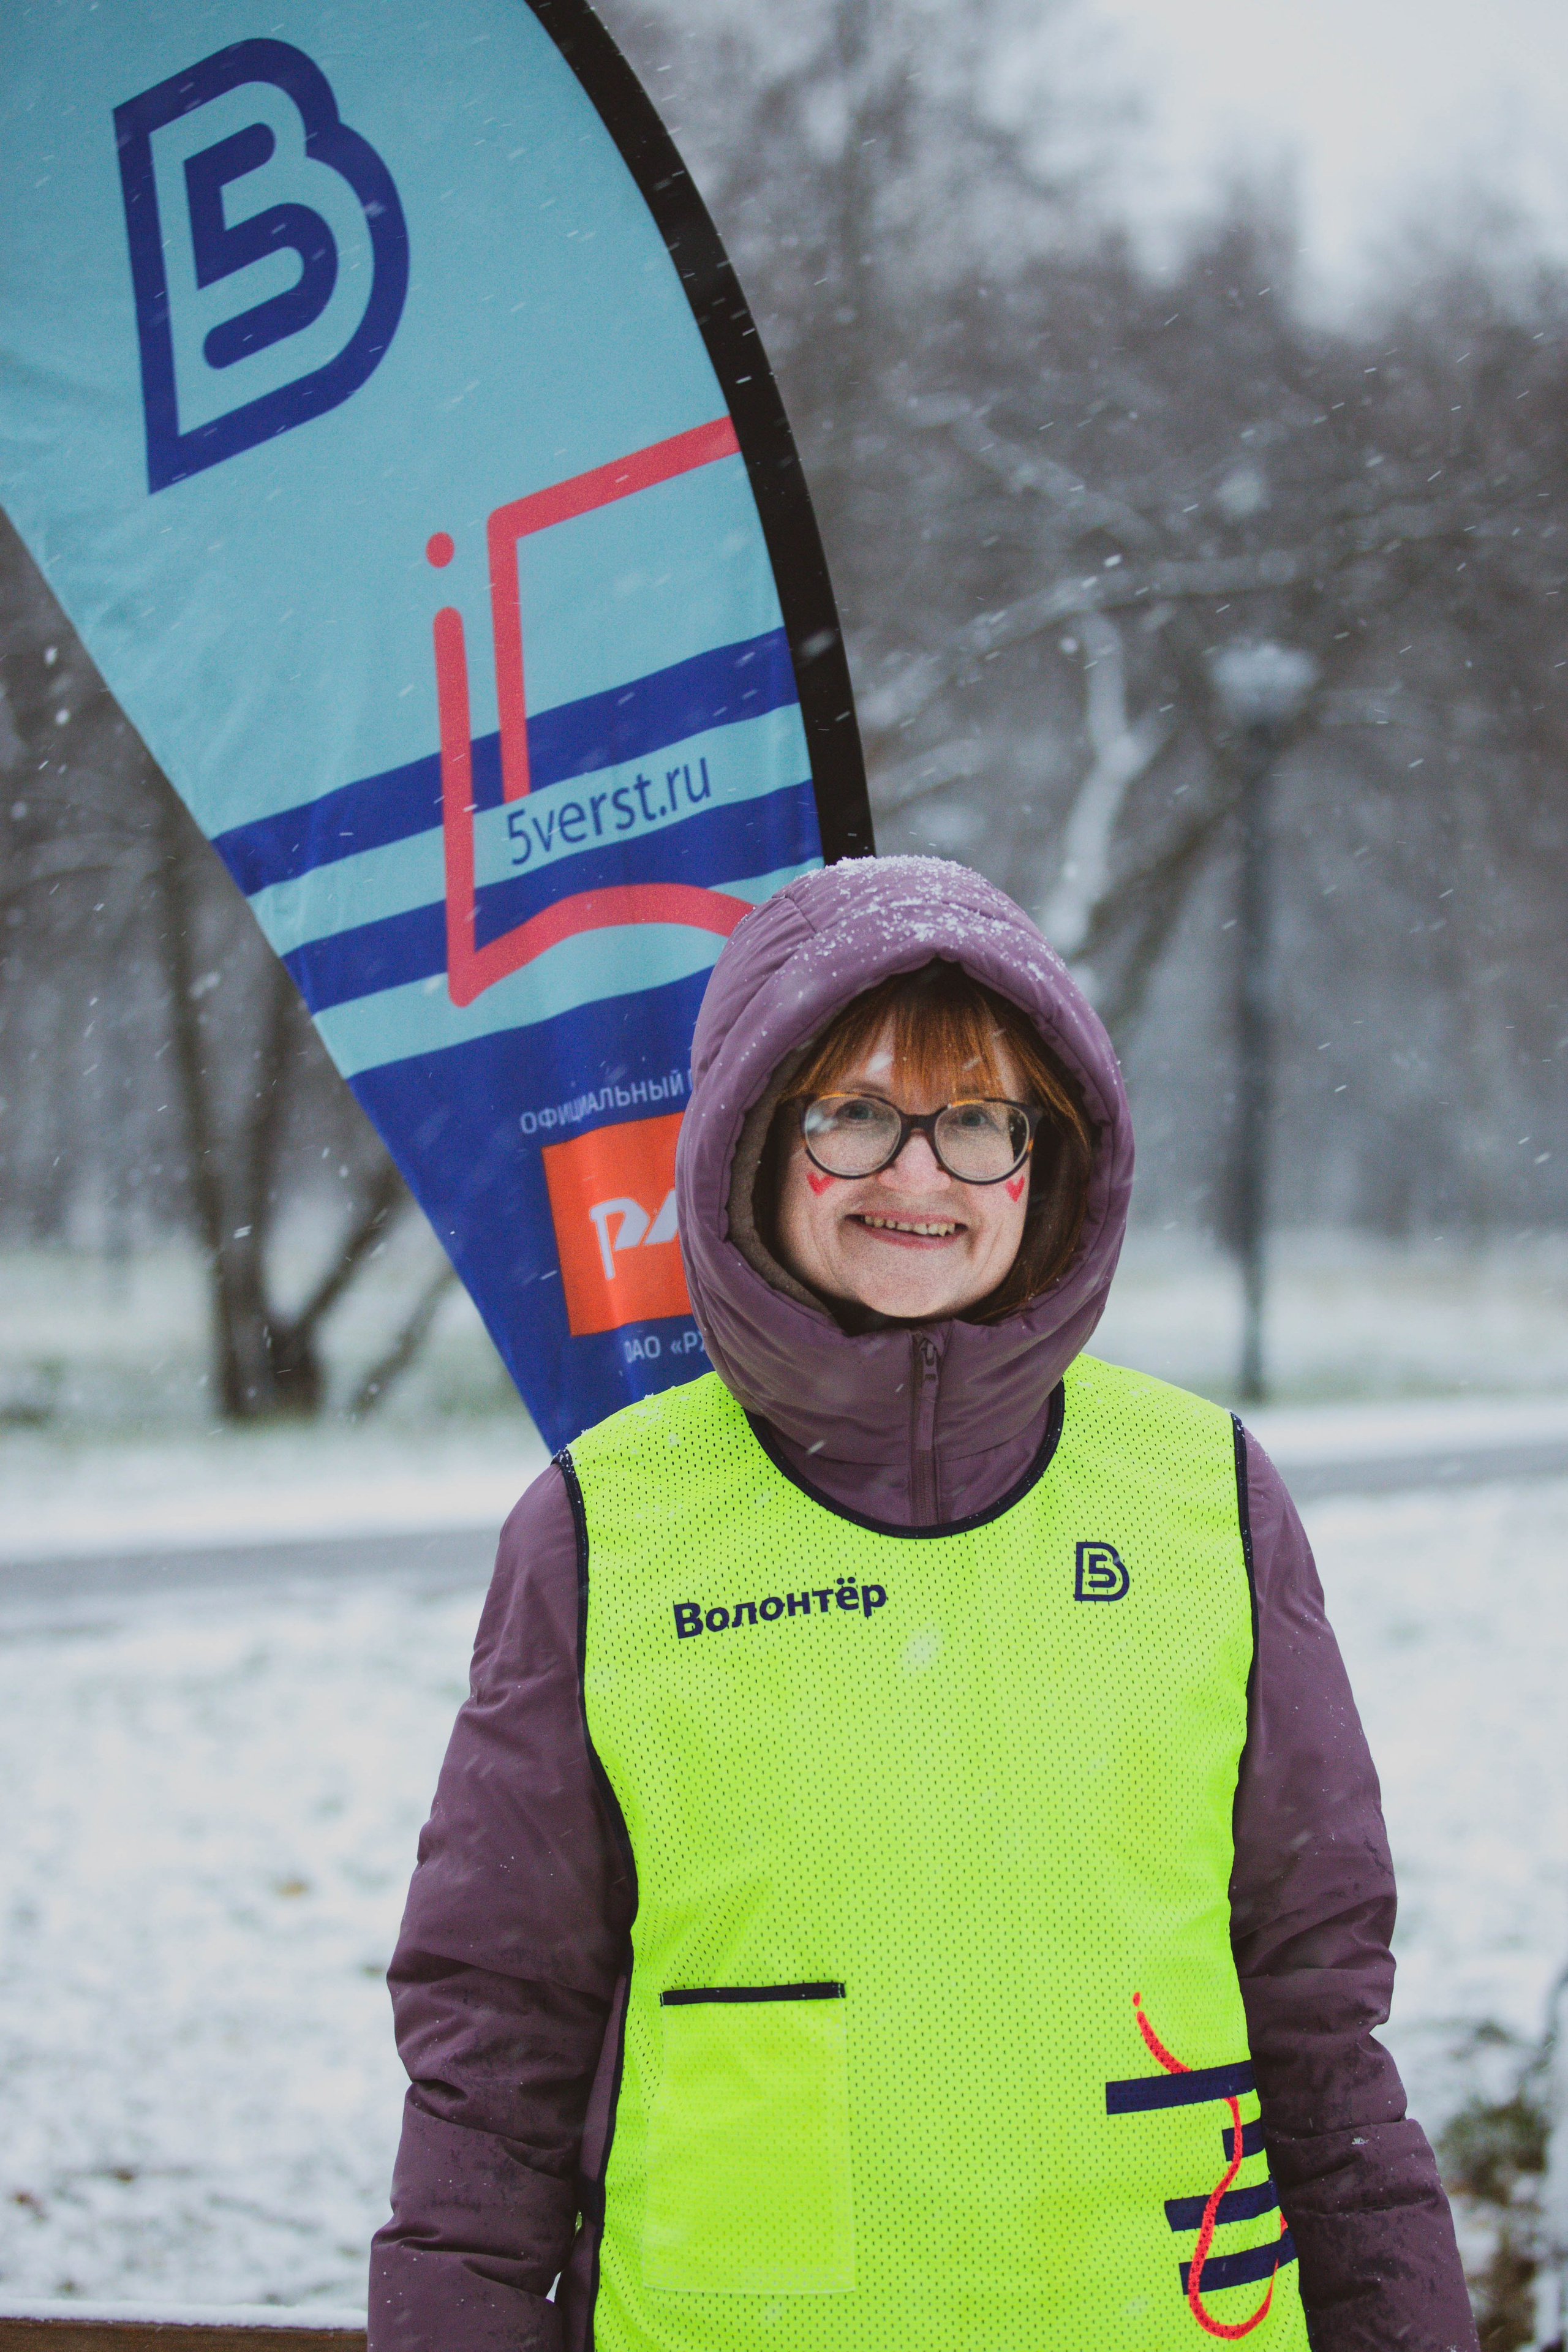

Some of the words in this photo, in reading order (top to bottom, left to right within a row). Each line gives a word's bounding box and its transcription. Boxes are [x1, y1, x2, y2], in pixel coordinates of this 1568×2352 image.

[507, 757, 711, 865] 5verst.ru
[521, 1069, 685, 1134] ОФИЦИАЛЬНЫЙ
[674, 1577, 888, 1639] Волонтёр
